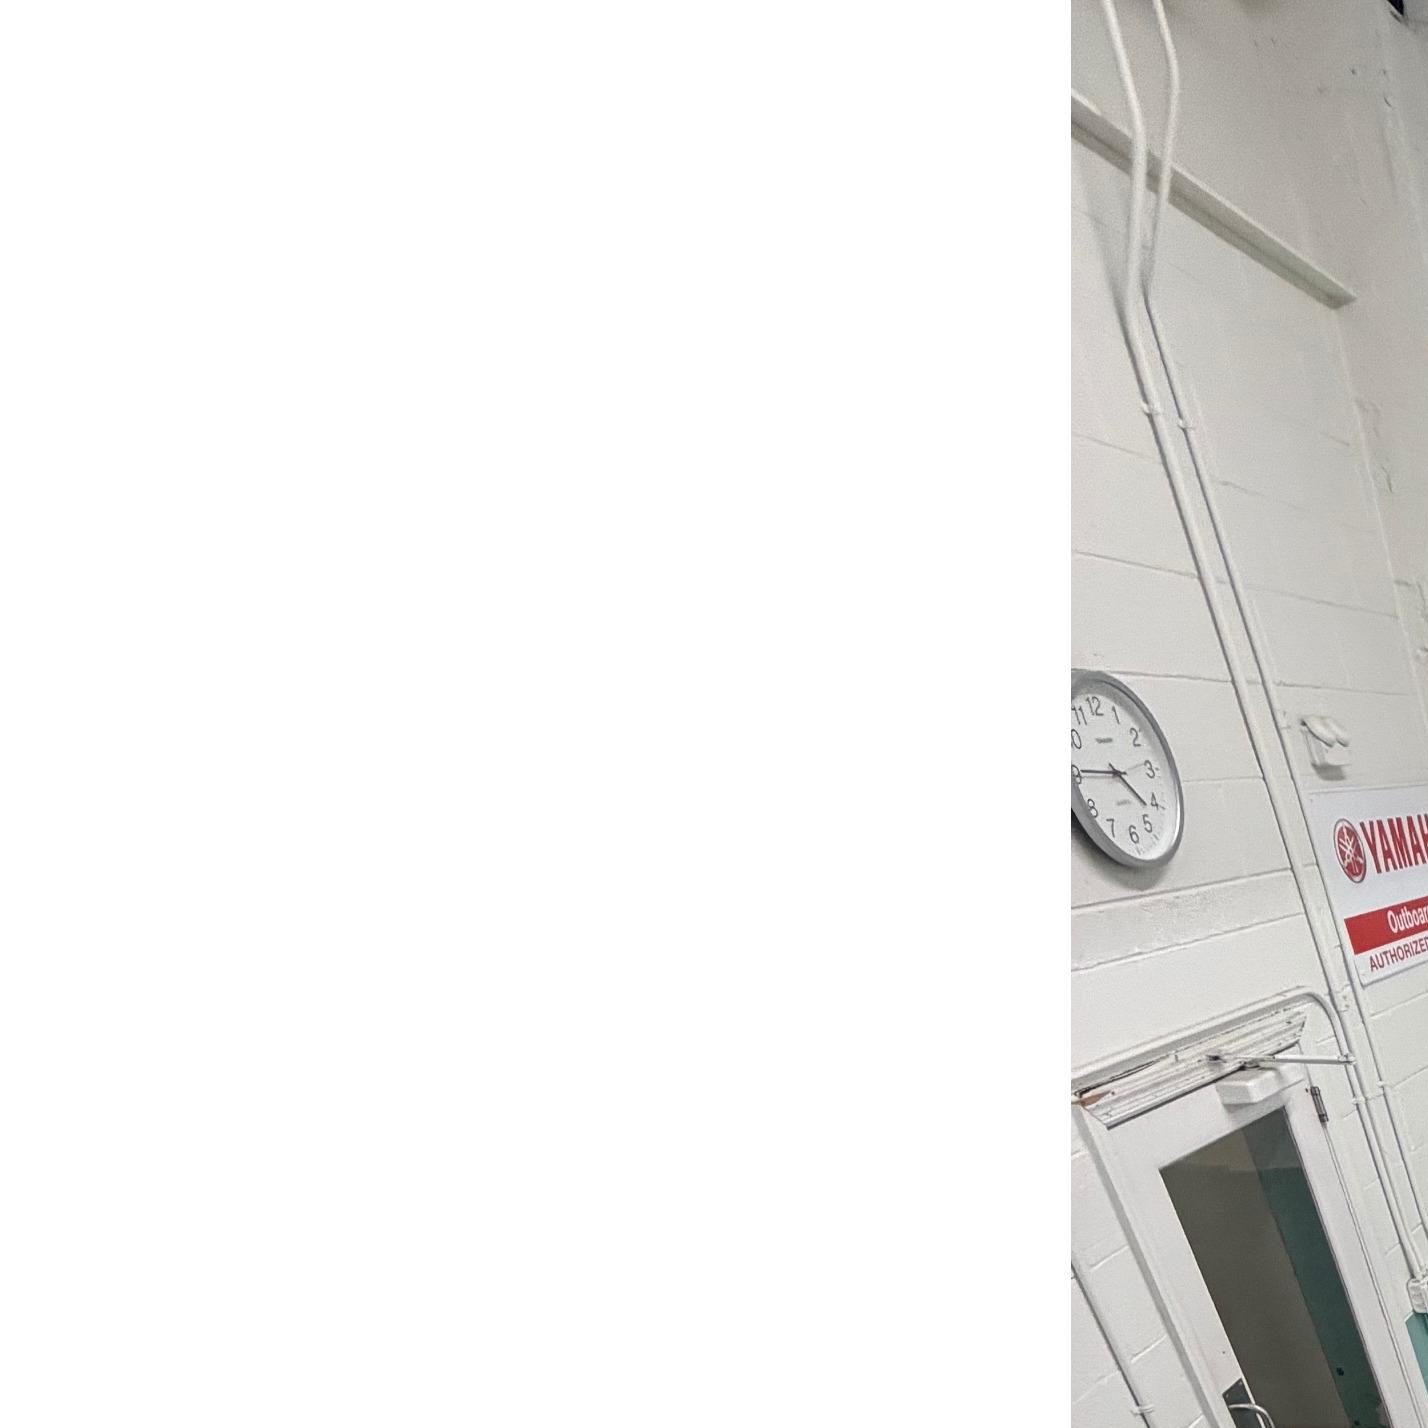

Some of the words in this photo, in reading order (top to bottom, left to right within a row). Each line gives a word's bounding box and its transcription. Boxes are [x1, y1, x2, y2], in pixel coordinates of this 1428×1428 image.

[1086, 696, 1104, 716] 12
[1111, 706, 1120, 725] 1
[1129, 727, 1142, 747] 2
[1143, 759, 1156, 779] 3
[1087, 798, 1099, 819] 8
[1150, 792, 1162, 811] 4
[1105, 818, 1116, 838] 7
[1142, 813, 1153, 834] 5
[1128, 824, 1140, 844] 6
